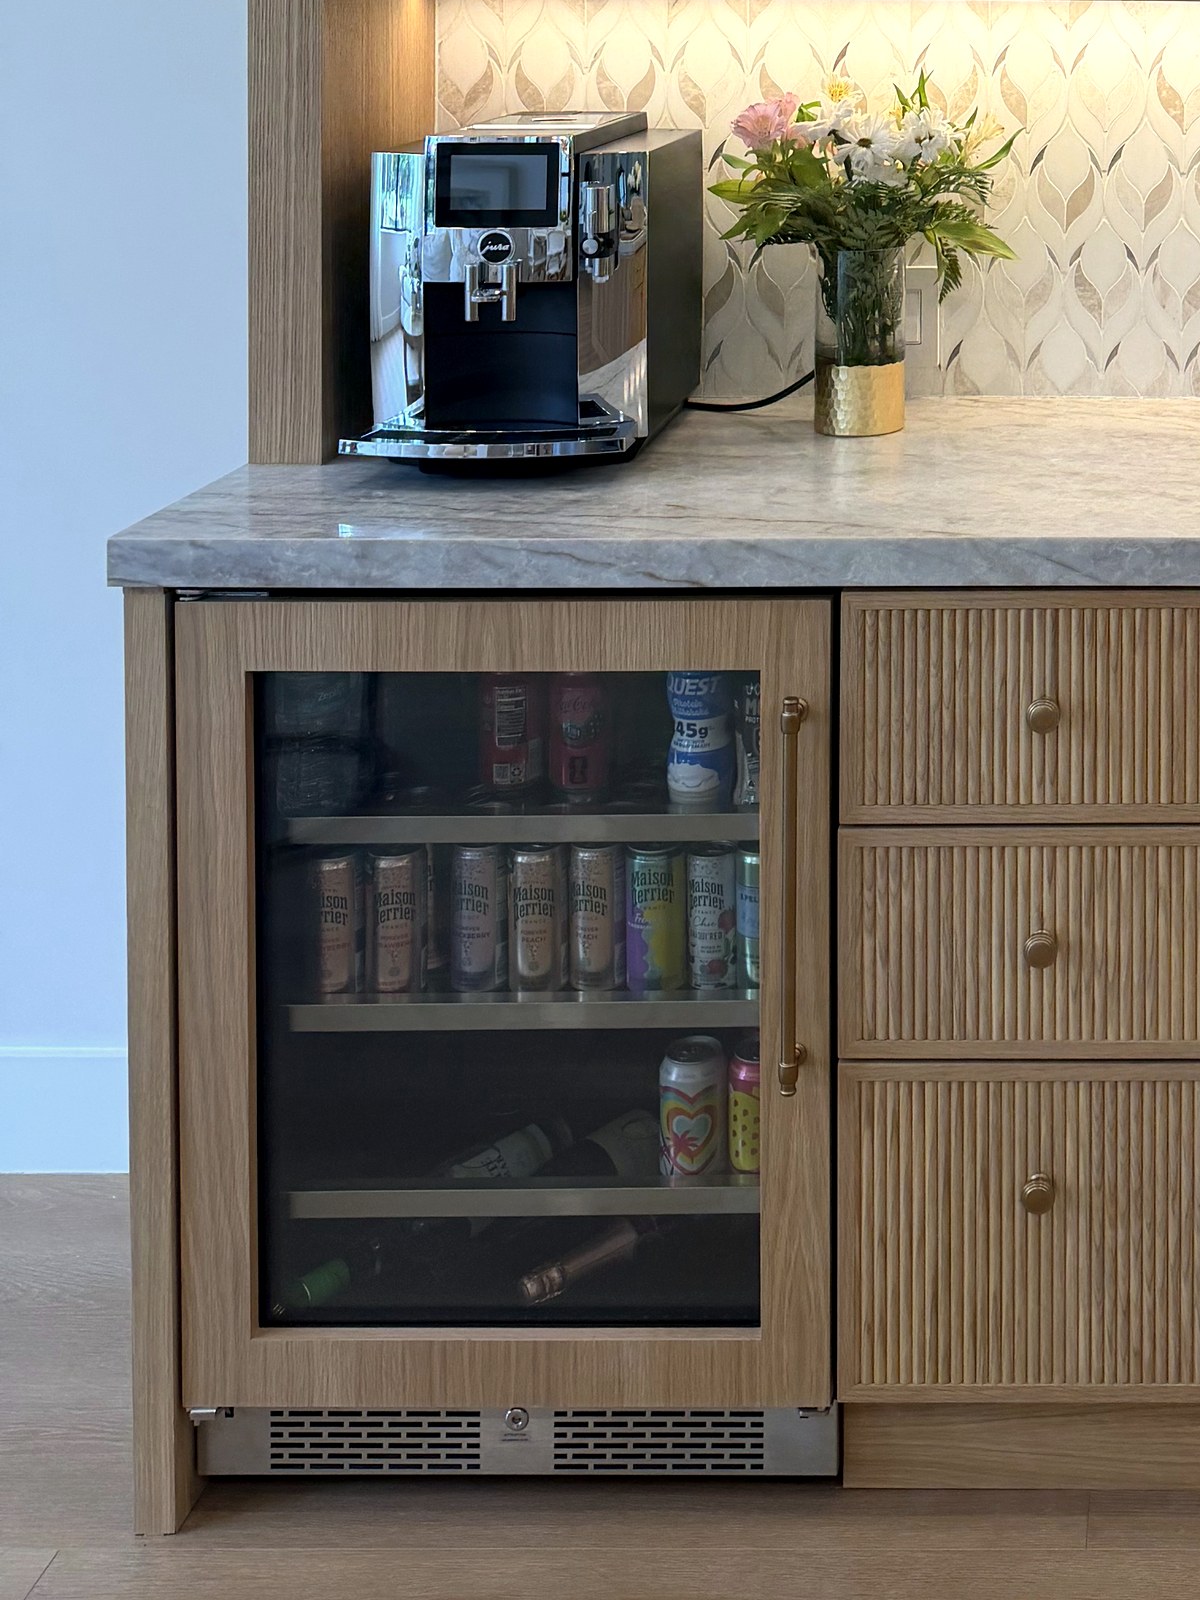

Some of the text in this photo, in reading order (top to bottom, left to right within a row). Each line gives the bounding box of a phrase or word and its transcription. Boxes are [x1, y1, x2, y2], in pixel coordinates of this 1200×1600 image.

[480, 241, 510, 255] jura
[667, 675, 723, 697] QUEST
[676, 721, 708, 739] 45g
[631, 869, 674, 888] Maison
[689, 878, 724, 897] Maison
[320, 892, 348, 910] ison
[513, 885, 554, 903] Maison
[631, 885, 675, 908] Perrier
[376, 904, 416, 925] errier
[456, 897, 490, 916] errier
[513, 900, 556, 930] Perrier
[573, 897, 608, 916] errier
[320, 908, 348, 925] rier
[521, 936, 547, 944] PEACH
